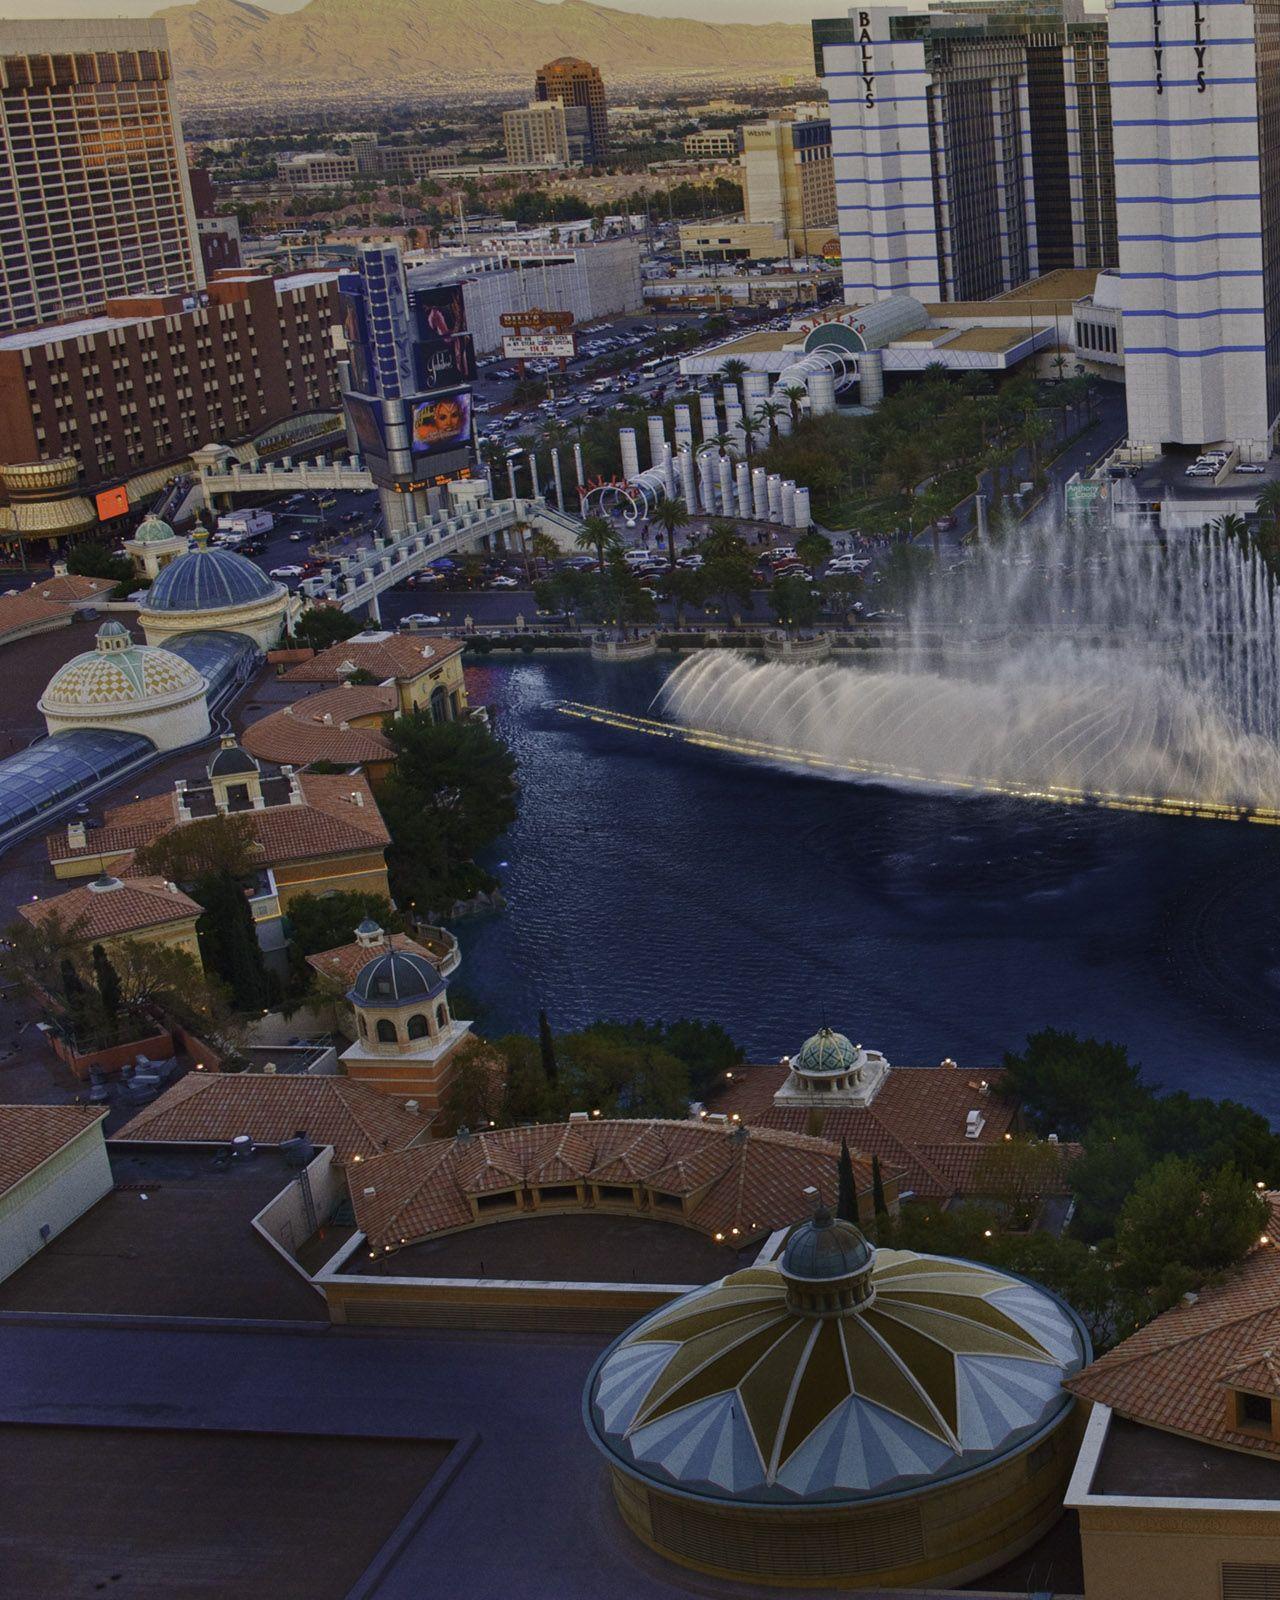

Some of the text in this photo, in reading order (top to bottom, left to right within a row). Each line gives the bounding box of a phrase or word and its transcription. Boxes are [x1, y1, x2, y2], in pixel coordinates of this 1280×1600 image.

[859, 11, 875, 109] BALLYS
[1152, 0, 1163, 95] LLYS
[799, 312, 866, 335] BALLYS
[1067, 485, 1100, 493] Anthony
